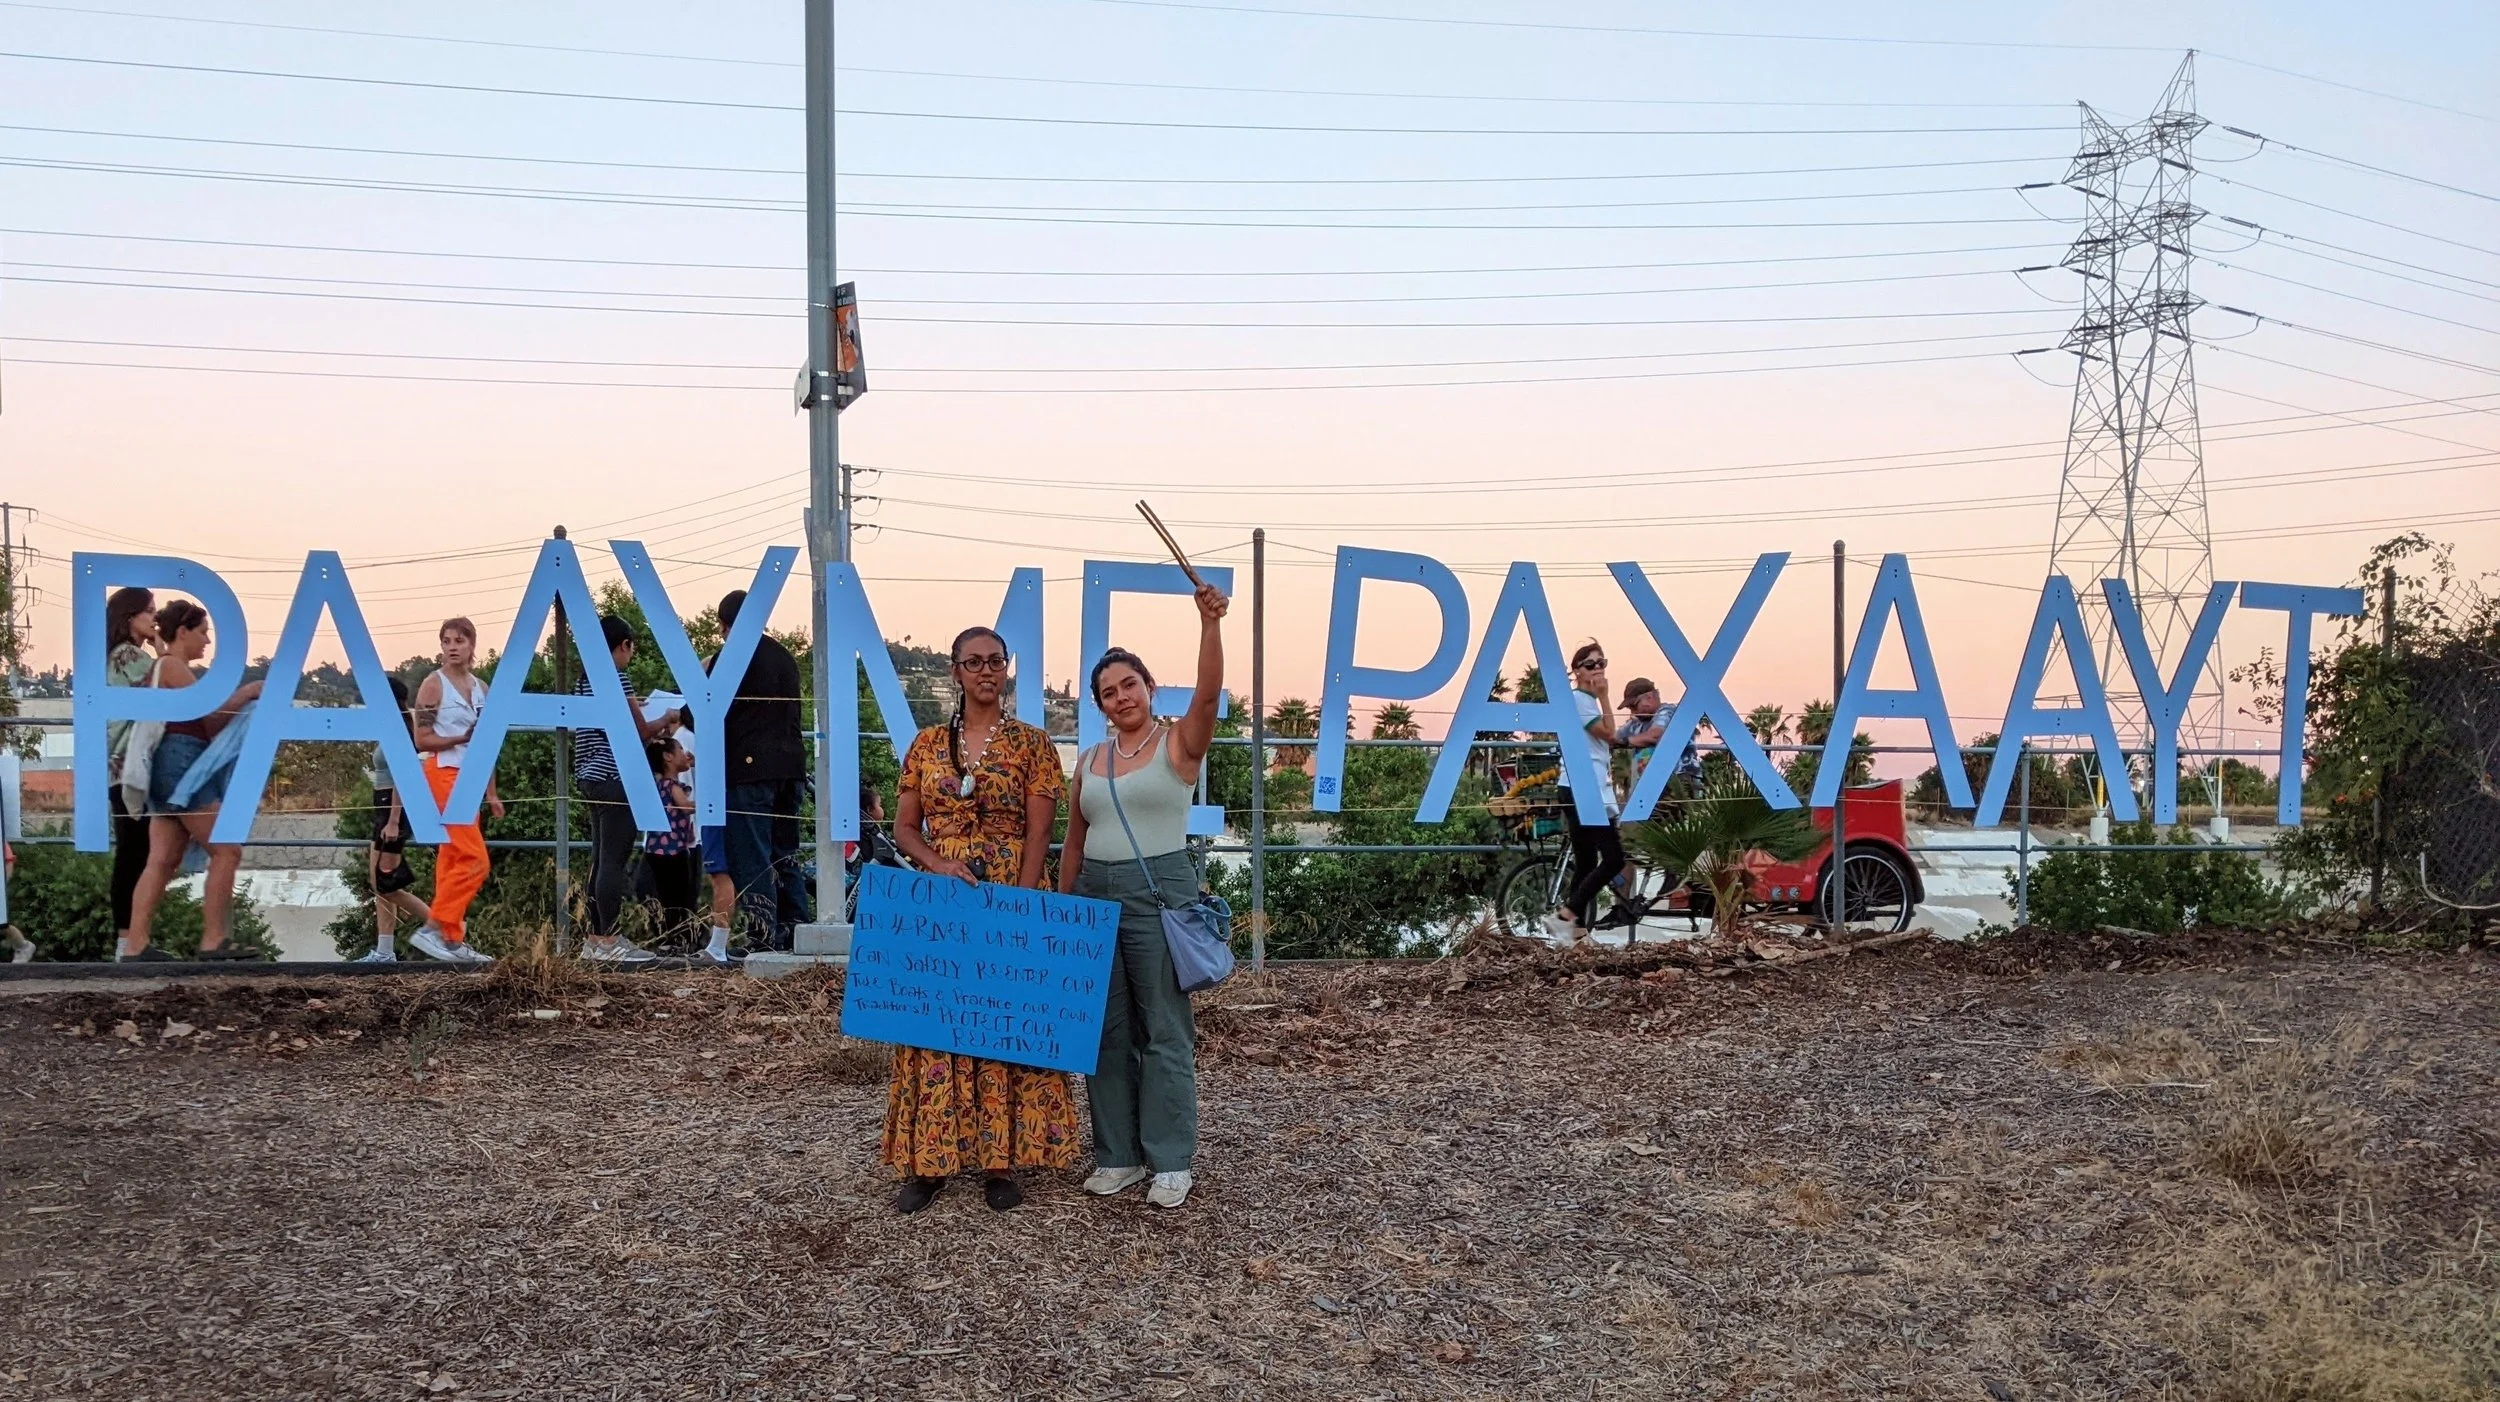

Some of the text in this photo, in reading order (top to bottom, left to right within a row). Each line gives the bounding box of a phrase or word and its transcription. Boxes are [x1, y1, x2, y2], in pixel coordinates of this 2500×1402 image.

[1313, 545, 2365, 828] PAXAAYT
[869, 871, 901, 900] NO
[911, 877, 965, 909] ONE
[858, 912, 882, 931] IN
